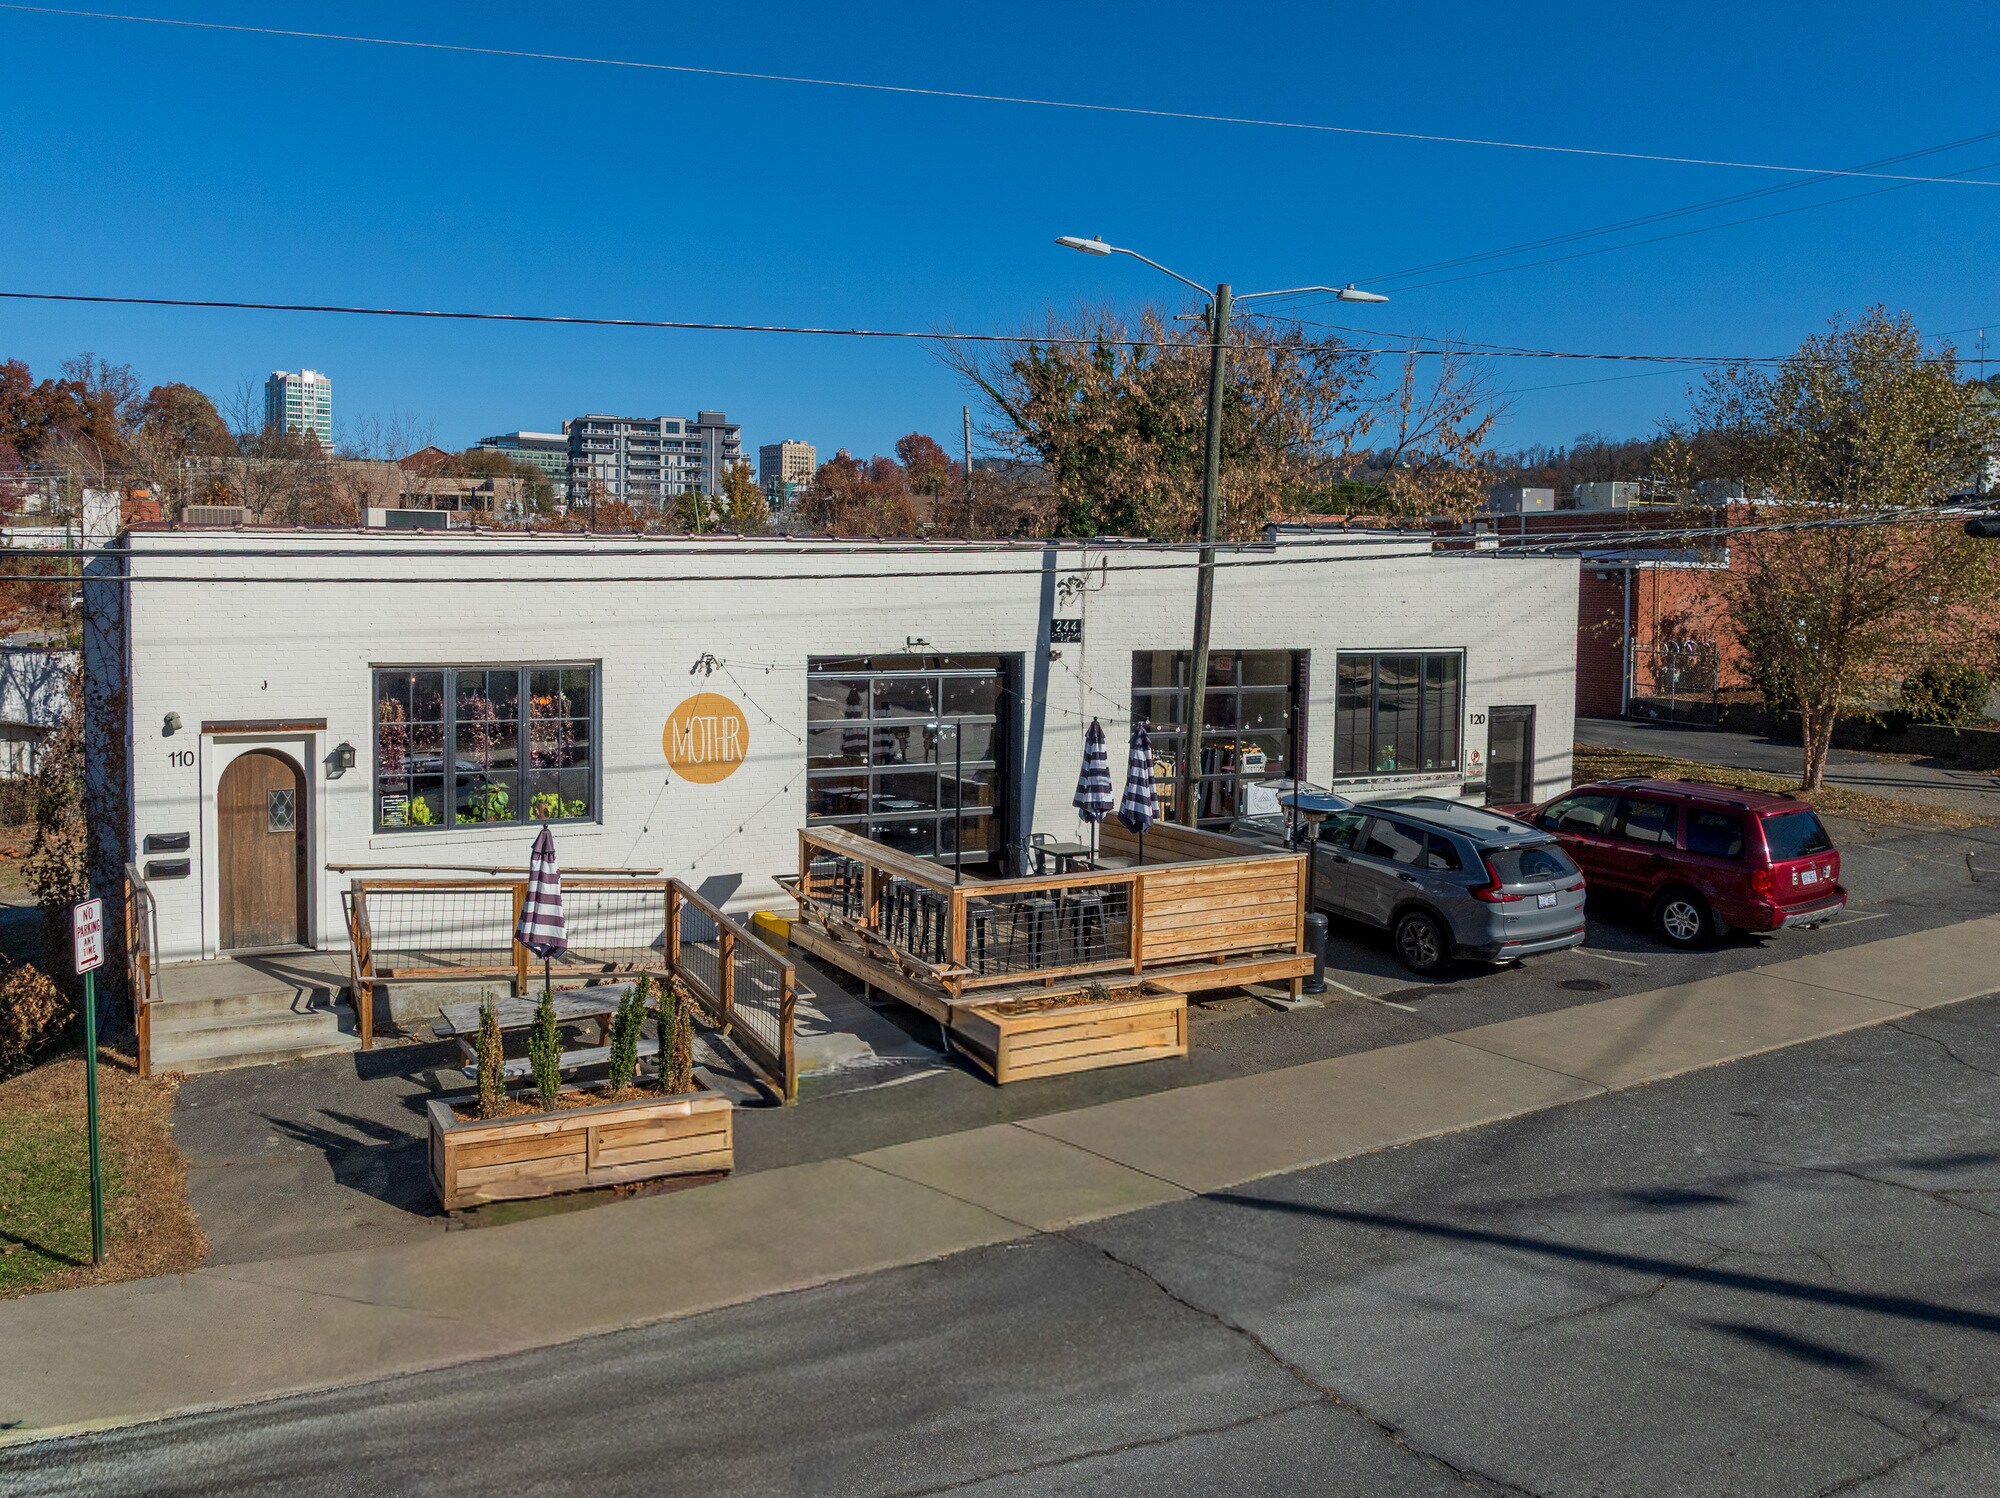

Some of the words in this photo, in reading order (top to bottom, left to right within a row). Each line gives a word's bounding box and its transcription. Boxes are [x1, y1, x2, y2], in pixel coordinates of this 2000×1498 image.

[1056, 620, 1077, 632] 244
[1469, 713, 1486, 725] 120
[672, 715, 743, 764] MOTHER
[167, 750, 195, 768] 110
[82, 906, 94, 922] NO
[77, 919, 101, 938] PARKING
[83, 936, 95, 947] ANY
[82, 944, 97, 957] TIME
